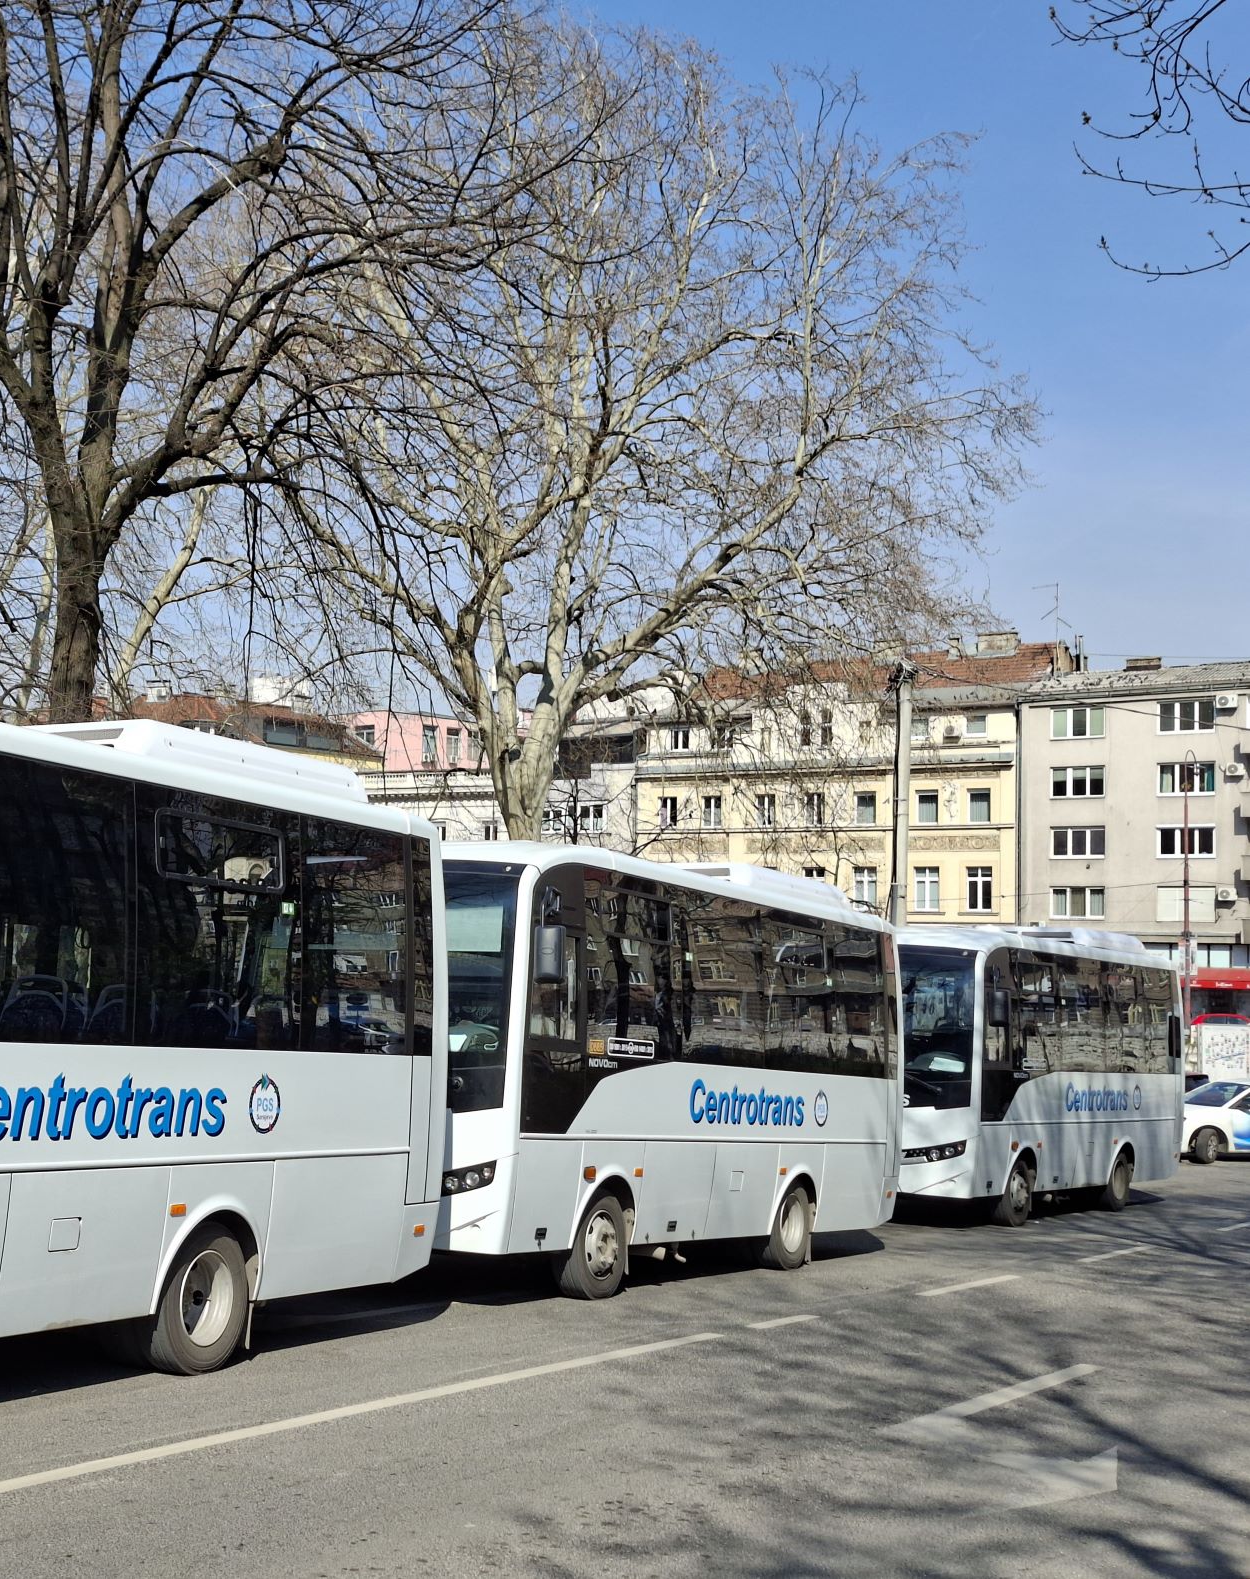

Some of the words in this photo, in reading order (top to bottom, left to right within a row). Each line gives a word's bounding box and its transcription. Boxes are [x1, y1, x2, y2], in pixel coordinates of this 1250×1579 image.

[256, 1097, 274, 1112] PGS
[689, 1078, 805, 1127] Centrotrans
[1065, 1081, 1128, 1112] Centrotrans
